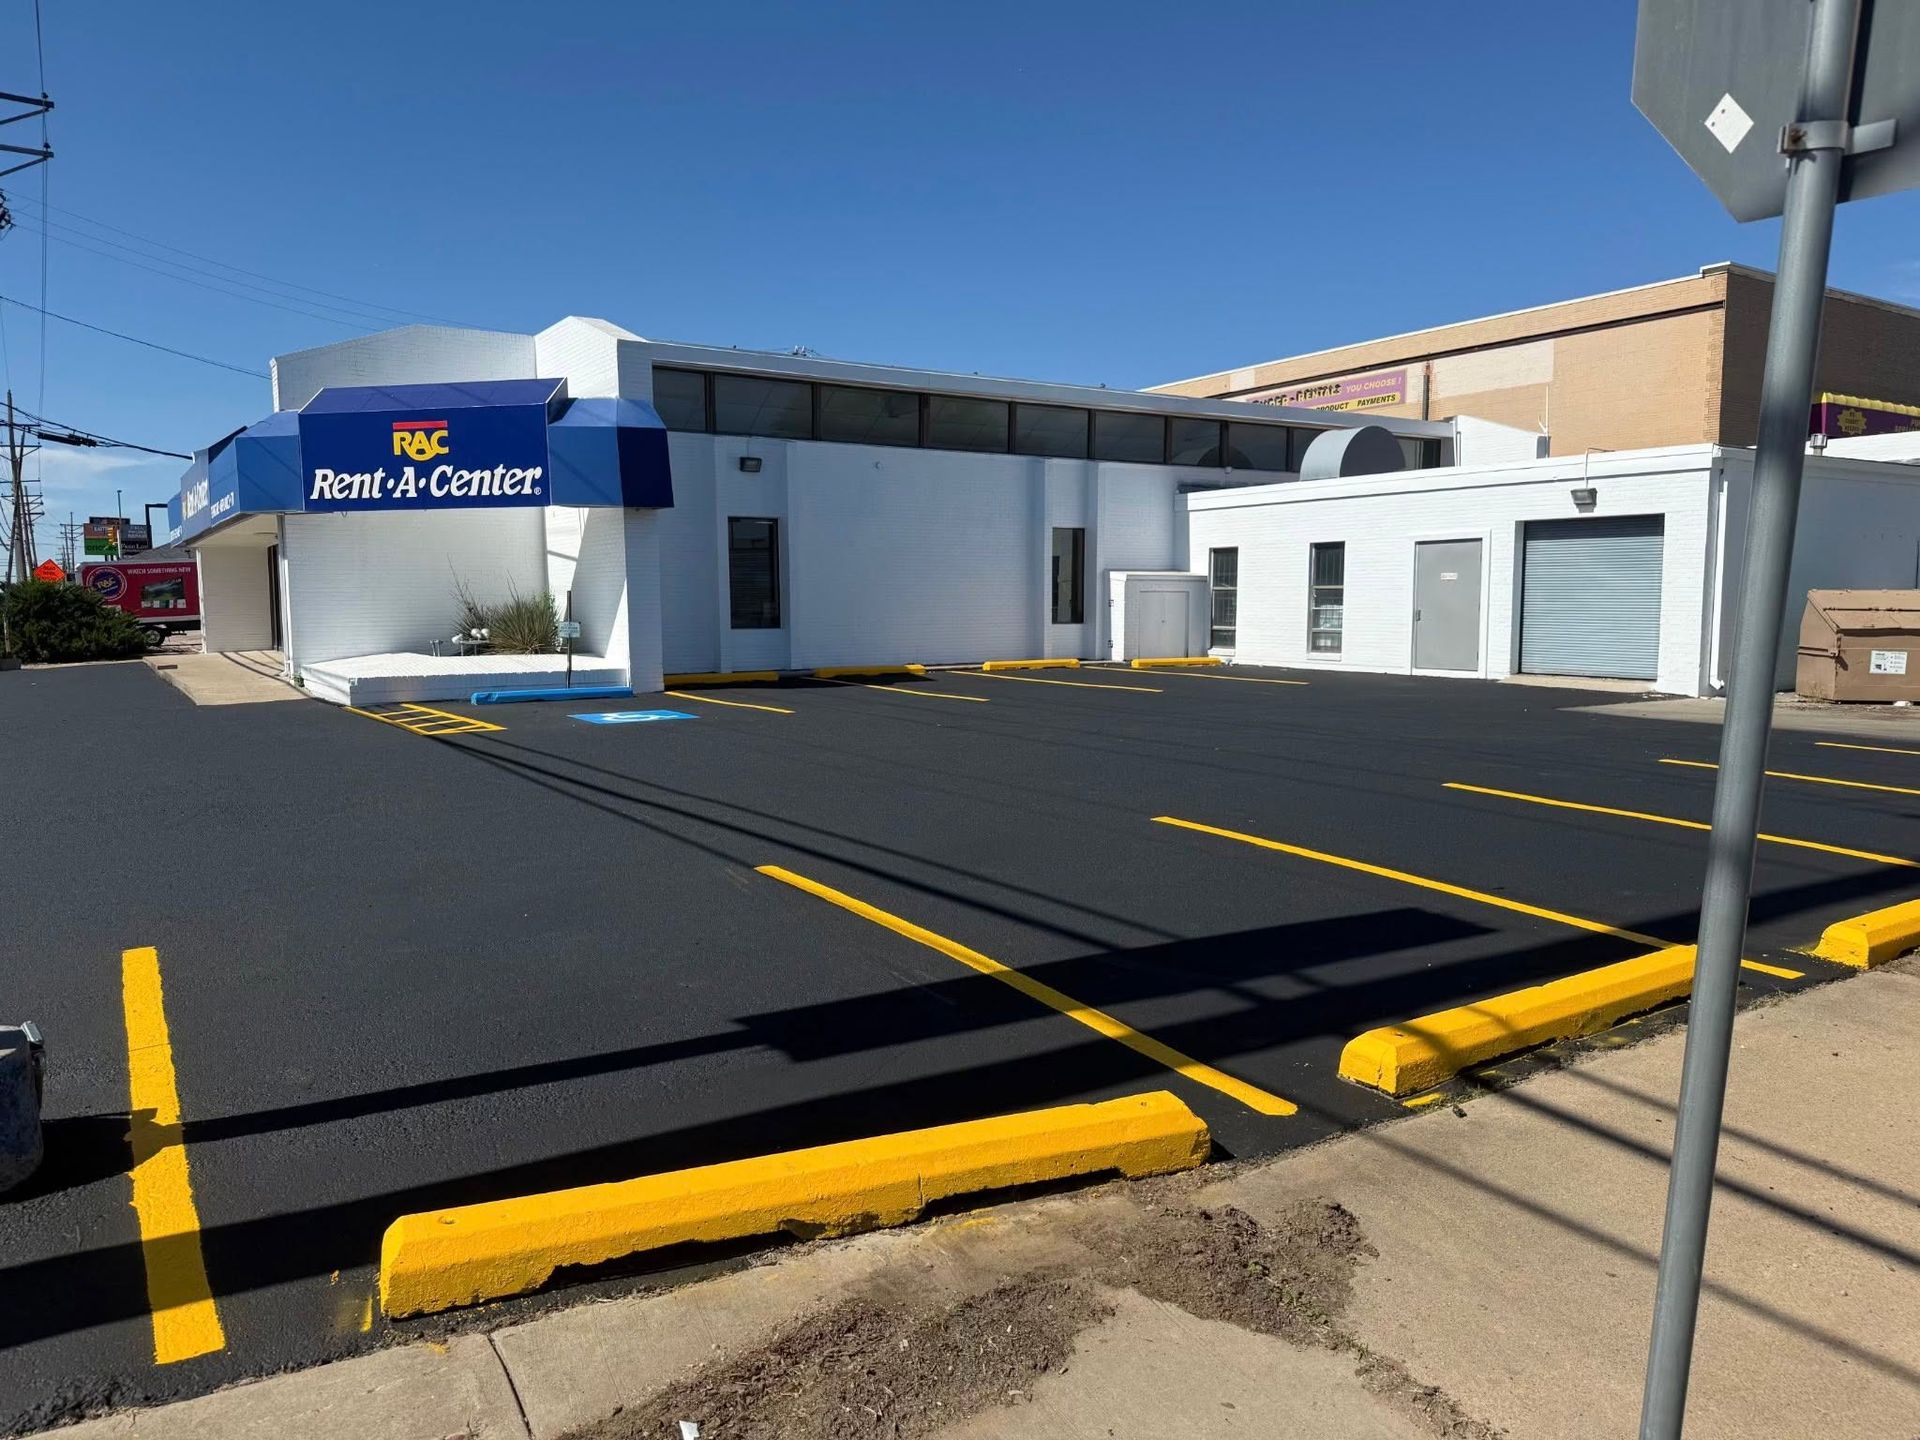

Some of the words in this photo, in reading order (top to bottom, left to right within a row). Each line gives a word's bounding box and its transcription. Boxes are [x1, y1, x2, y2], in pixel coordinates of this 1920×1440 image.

[1346, 384, 1361, 393] YOU
[1357, 394, 1396, 407] PAYMENTS
[393, 430, 449, 461] RAC
